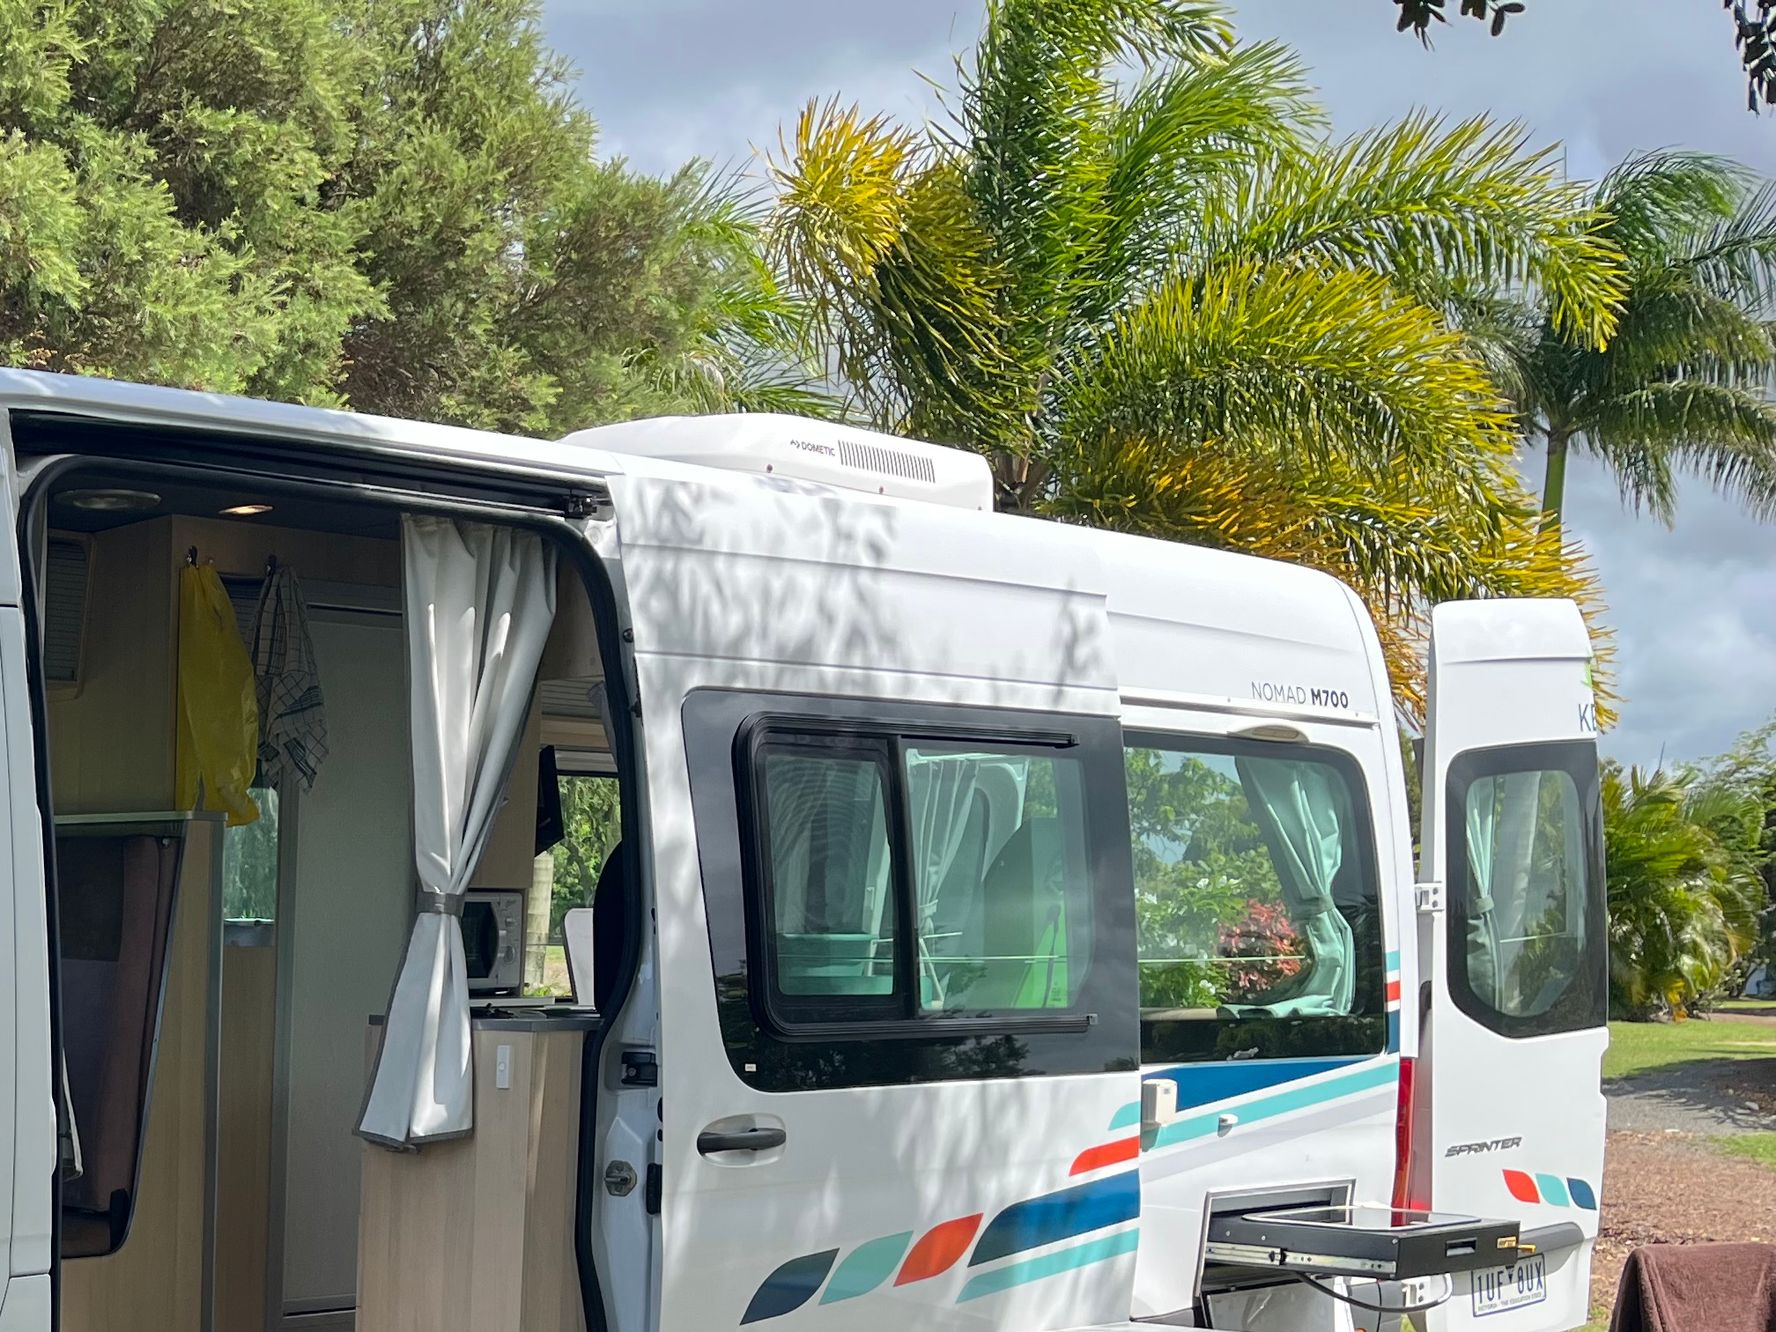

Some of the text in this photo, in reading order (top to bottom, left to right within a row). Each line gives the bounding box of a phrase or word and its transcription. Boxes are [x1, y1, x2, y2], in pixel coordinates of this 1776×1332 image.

[801, 441, 836, 457] DOMETIC
[1251, 681, 1349, 709] NOMAD M700
[1444, 1136, 1522, 1157] SPRINTER
